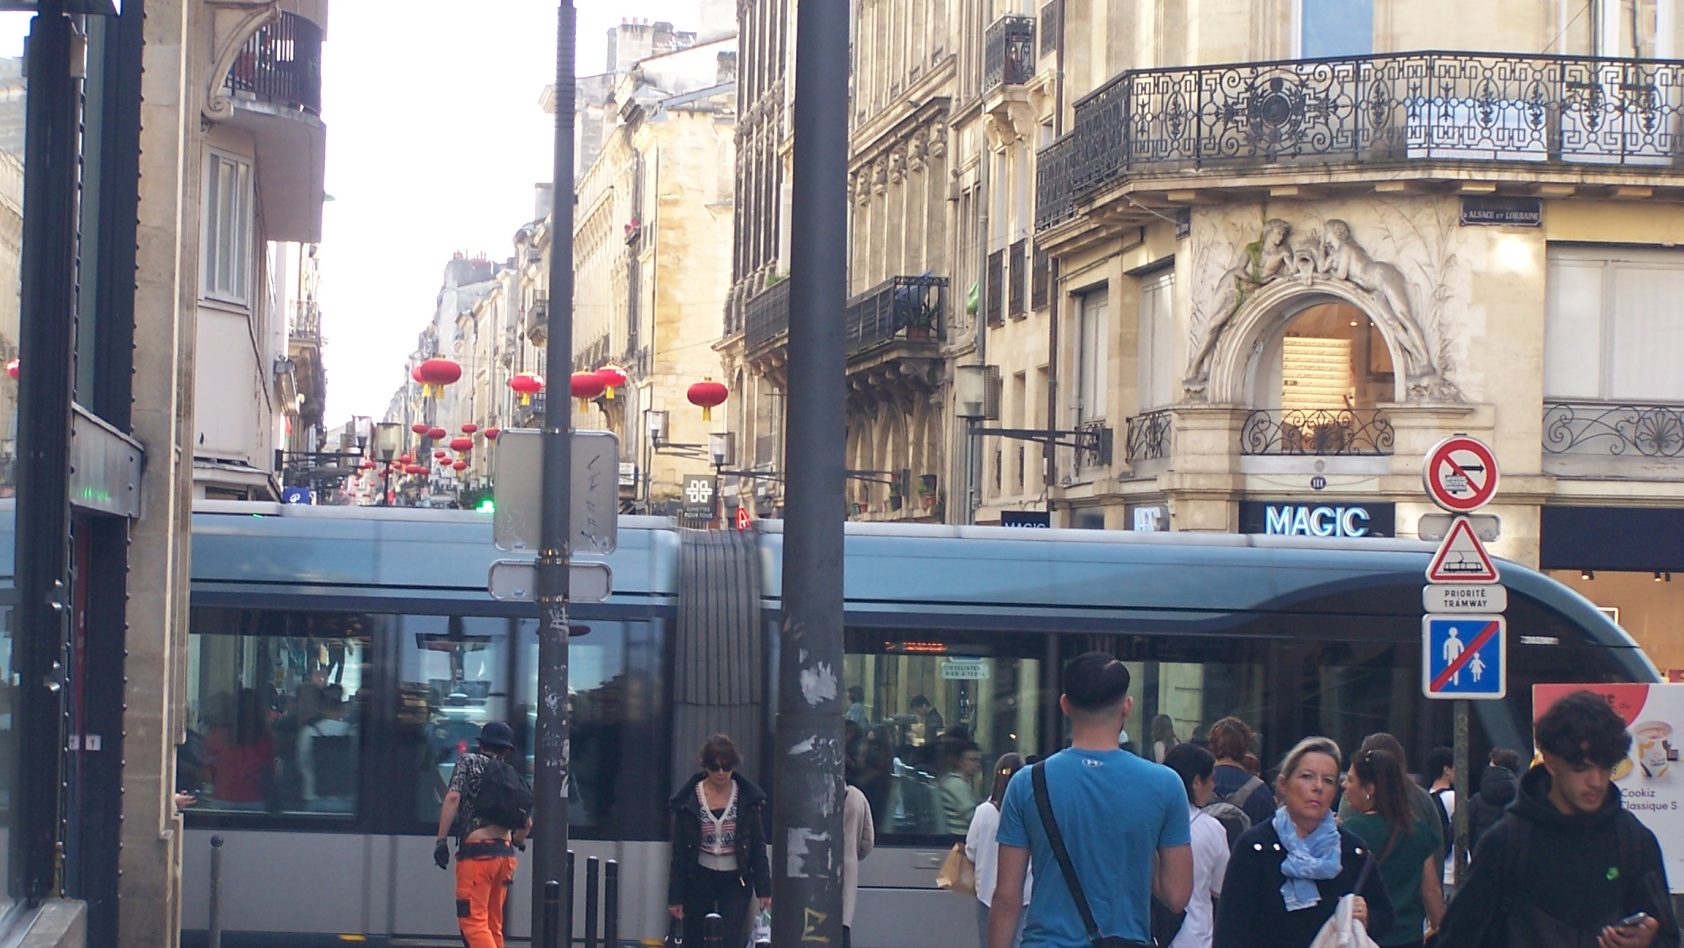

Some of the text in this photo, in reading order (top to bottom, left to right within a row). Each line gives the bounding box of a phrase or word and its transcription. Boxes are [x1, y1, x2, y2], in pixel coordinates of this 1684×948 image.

[1265, 505, 1371, 537] MAGIC
[1444, 588, 1487, 598] PRIORITÉ
[1443, 599, 1488, 608] TRAMWAY
[1621, 788, 1656, 798] Cookiz
